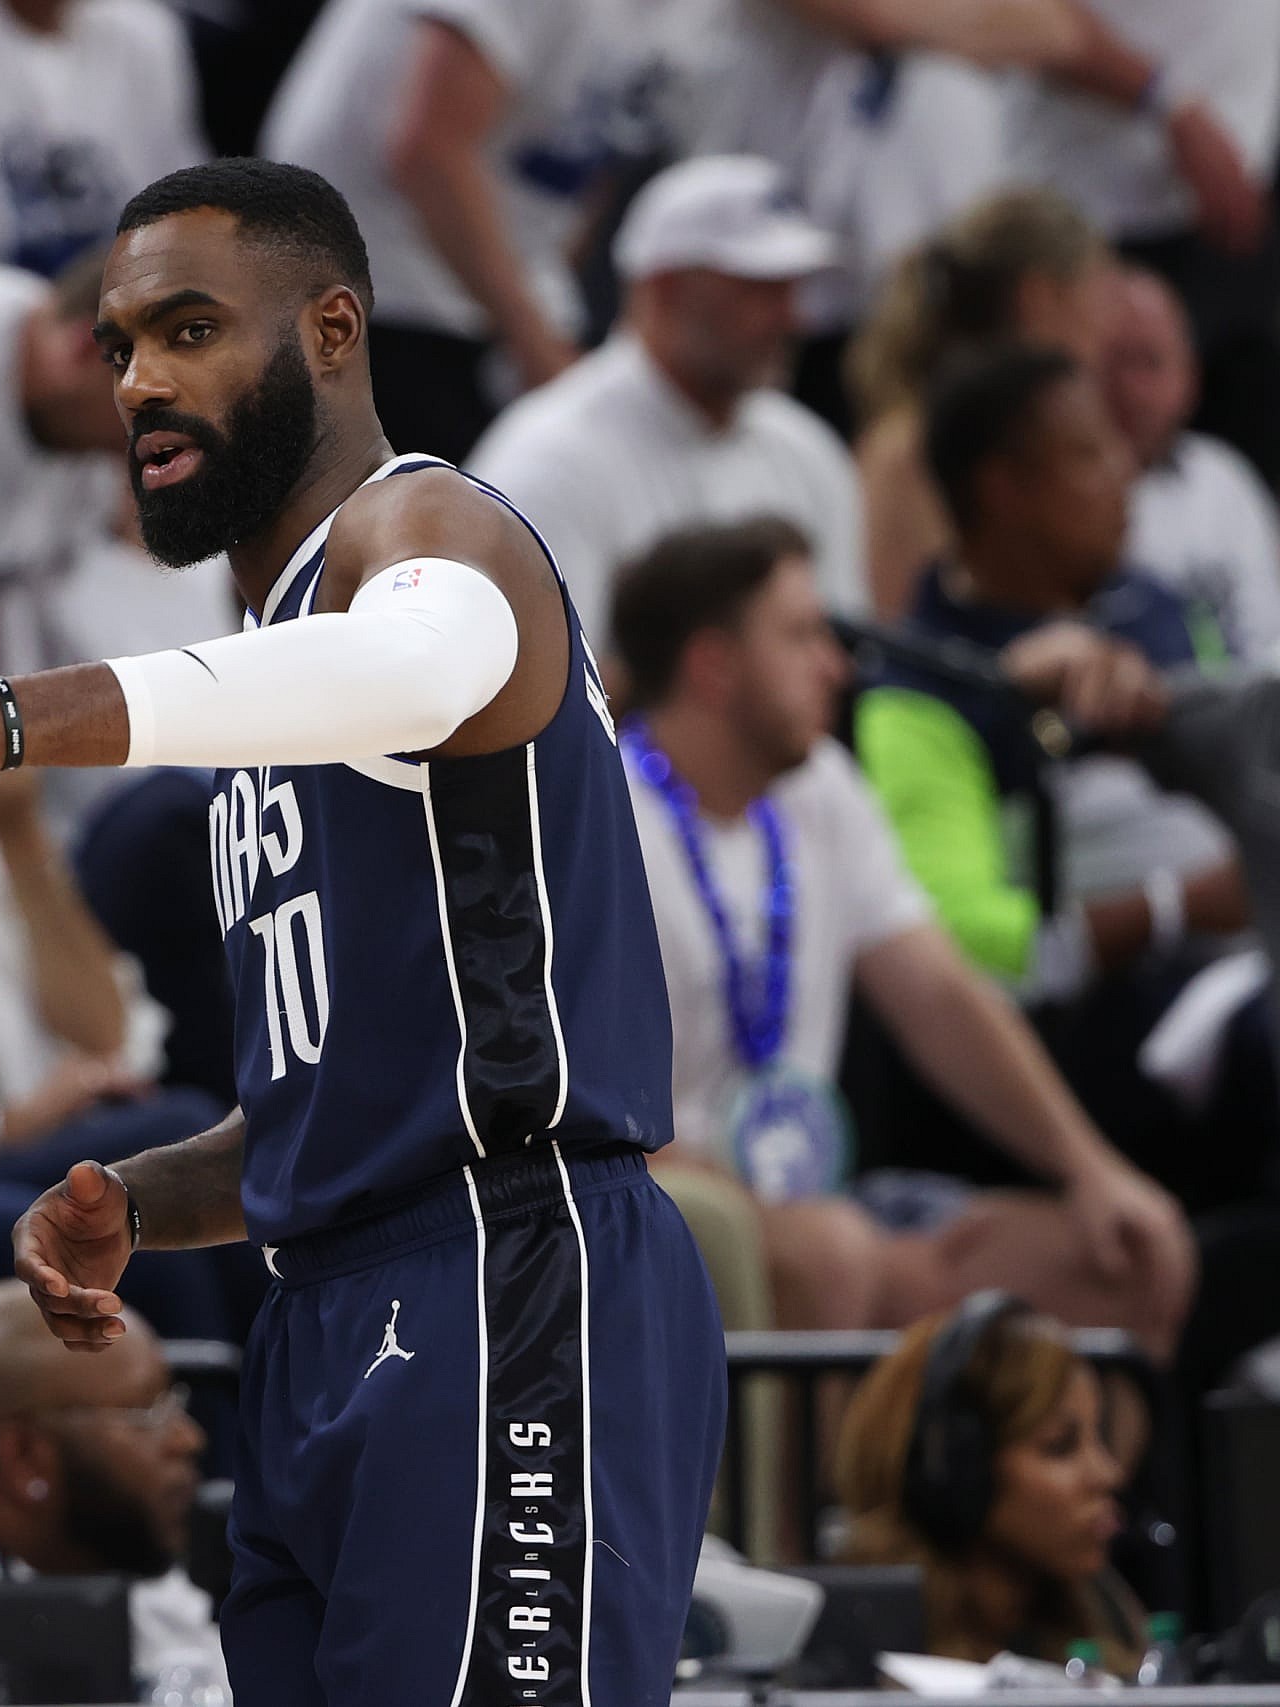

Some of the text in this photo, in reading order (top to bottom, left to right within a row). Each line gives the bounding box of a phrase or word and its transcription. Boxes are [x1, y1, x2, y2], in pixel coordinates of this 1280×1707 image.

[208, 766, 304, 942] MAS
[248, 889, 330, 1081] 10
[507, 1422, 554, 1707] ERICKS
